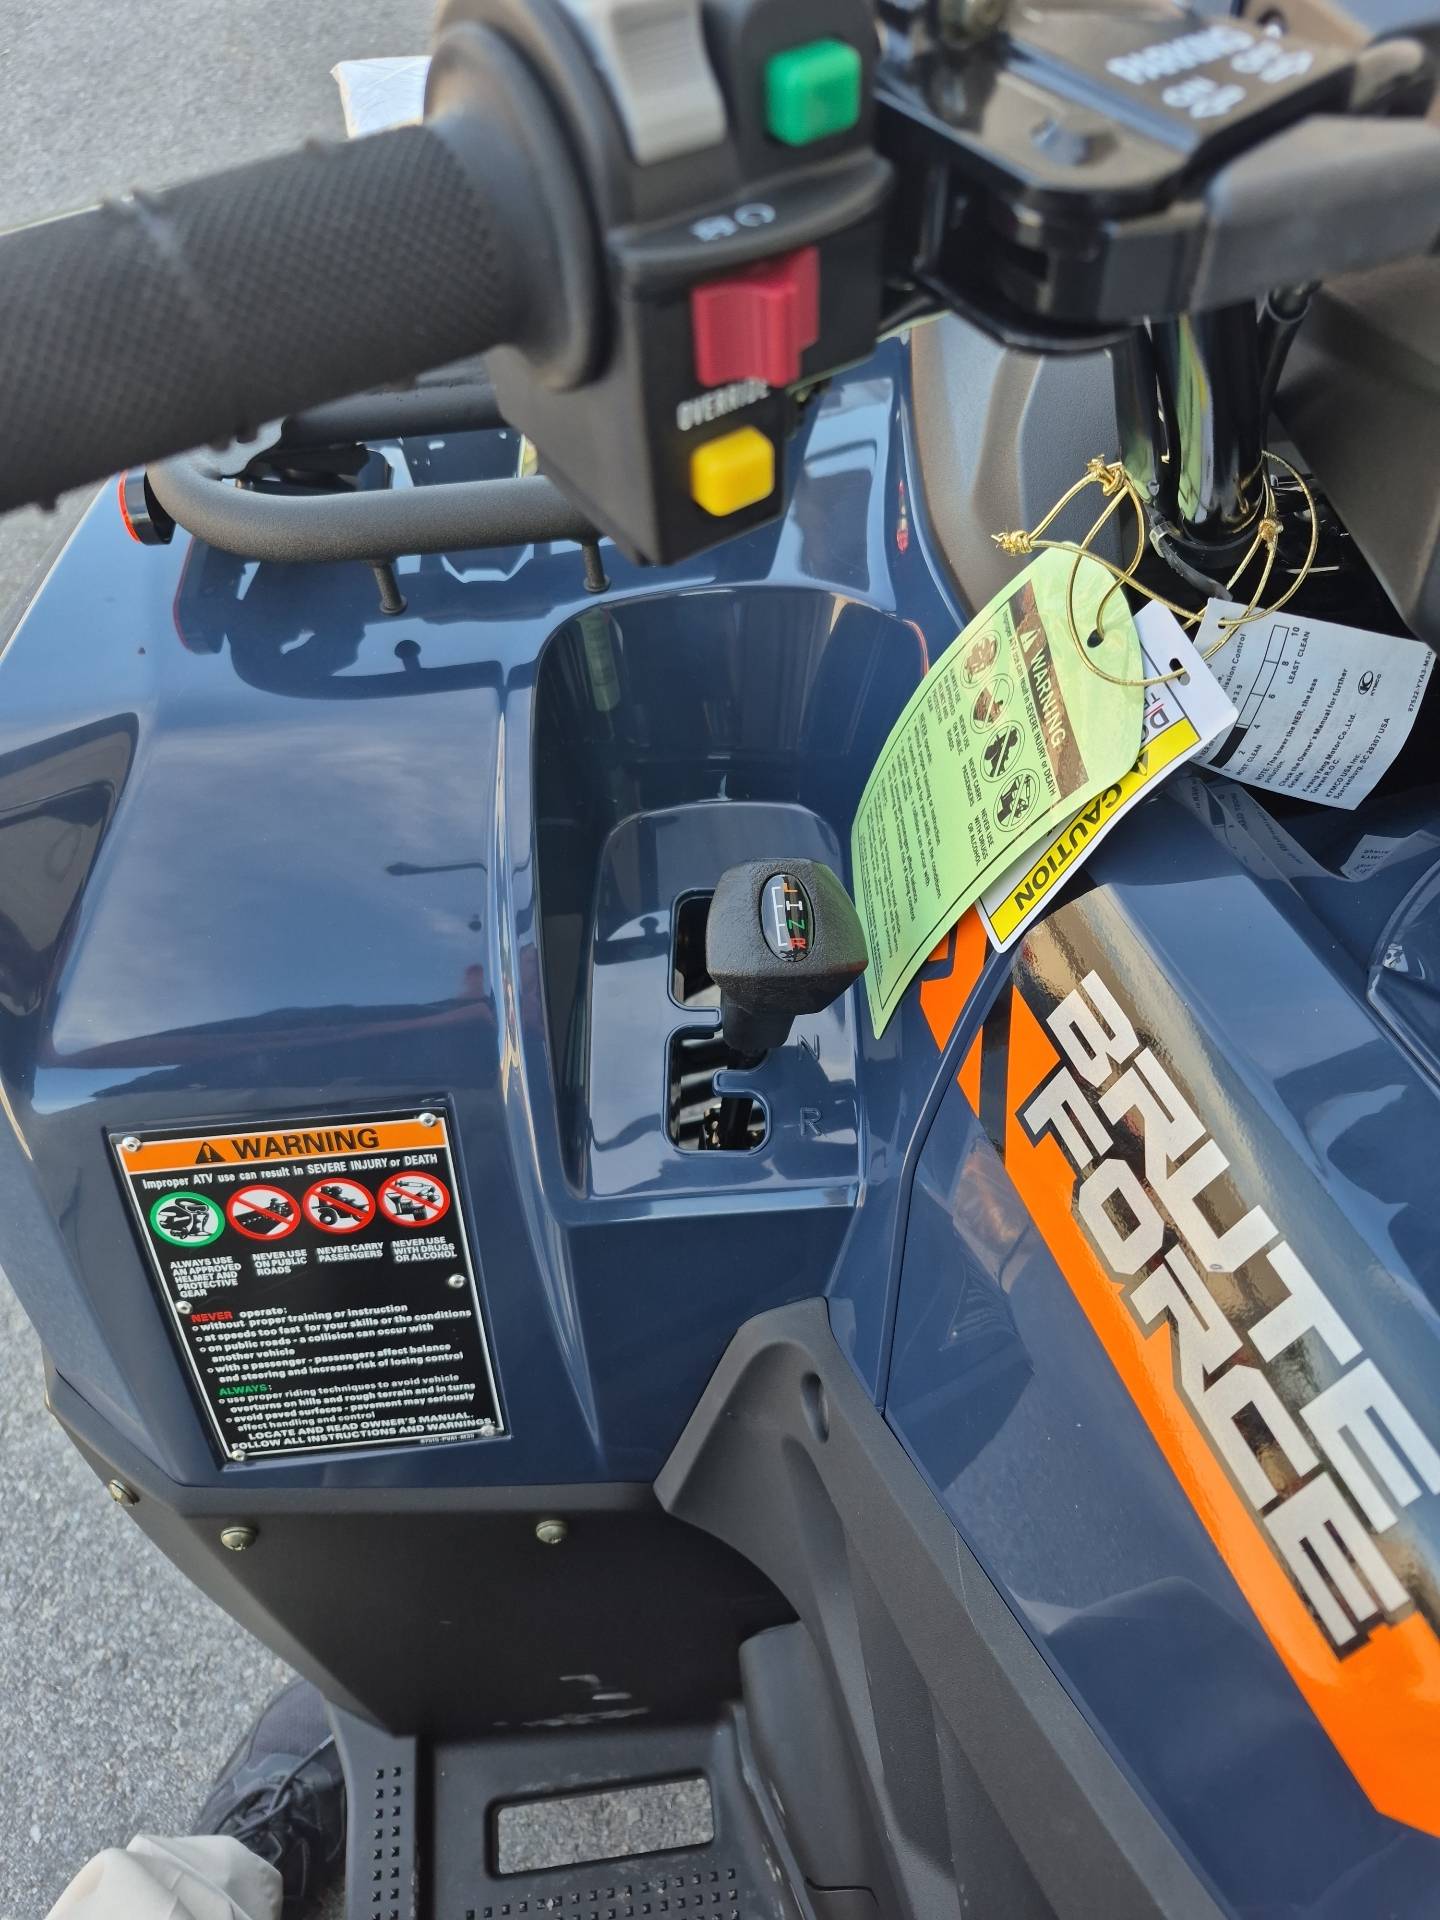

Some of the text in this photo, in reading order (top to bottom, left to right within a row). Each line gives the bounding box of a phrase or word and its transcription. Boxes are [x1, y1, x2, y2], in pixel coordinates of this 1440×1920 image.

[1291, 627, 1300, 636] 10
[1232, 633, 1246, 664] Control
[1287, 631, 1310, 684] LEAST CLEAN
[1370, 673, 1382, 696] KYMCO
[1031, 648, 1067, 748] WARNING
[1286, 726, 1295, 738] the
[1301, 694, 1310, 708] the
[1307, 678, 1318, 693] less
[1313, 710, 1331, 736] Manual
[1327, 697, 1336, 708] for
[1332, 668, 1348, 696] further
[1377, 718, 1390, 735] USA
[1025, 702, 1036, 733] SEVERE
[1034, 732, 1046, 760] INJURY
[1043, 767, 1056, 796] DEATH
[972, 777, 983, 802] CARRY
[973, 814, 989, 861] WITH DRUGS
[981, 807, 995, 848] NEVER USE
[970, 832, 981, 867] ALCOHOL
[1014, 784, 1122, 911] CAUTION
[784, 883, 798, 892] L
[786, 900, 803, 910] H
[788, 919, 805, 929] N
[790, 937, 806, 949] R
[800, 1106, 823, 1137] R
[231, 1127, 379, 1159] WARNING
[141, 1153, 438, 1190] Improper ATV use can result in SEVERE INJURY or DEATH
[316, 1241, 384, 1255] NEVER CARRY
[391, 1236, 446, 1248] NEVER USE
[393, 1242, 454, 1255] WITH DRUGS
[1046, 969, 1440, 1535] BRUTE
[169, 1255, 234, 1268] ALWAYS USE
[251, 1249, 307, 1261] NEVER USE
[254, 1256, 307, 1268] ON PUBLIC
[318, 1249, 383, 1262] PASSENGERS
[394, 1249, 457, 1262] OR ALCOHOL
[171, 1262, 241, 1276] AN APPROVED
[174, 1270, 238, 1283] HELMET AND
[256, 1265, 292, 1276] ROADS
[176, 1278, 238, 1291] PROTECTIVE
[179, 1288, 207, 1298] GEAR
[190, 1306, 288, 1323] NEVER operate:
[199, 1303, 408, 1331] without proper training or instruction
[216, 1329, 257, 1341] speeds
[257, 1328, 277, 1336] too
[278, 1324, 301, 1334] fast
[303, 1322, 321, 1332] for
[321, 1321, 349, 1332] your
[349, 1317, 379, 1328] skills
[379, 1317, 393, 1325] or
[393, 1314, 413, 1323] the
[413, 1308, 472, 1322] conditions
[207, 1344, 223, 1352] on
[223, 1340, 260, 1352] public
[258, 1336, 291, 1347] roads
[306, 1330, 355, 1343] collision
[355, 1330, 375, 1338] can
[376, 1326, 408, 1336] occur
[407, 1322, 434, 1333] with
[211, 1347, 296, 1363] another vehicle
[214, 1362, 241, 1373] with
[250, 1358, 307, 1371] passenger
[313, 1351, 376, 1364] passengers
[375, 1346, 408, 1357] affect
[408, 1342, 451, 1354] balance
[218, 1350, 464, 1383] and steering and increase risk of losing control
[1023, 1068, 1411, 1646] FORCE
[229, 1382, 476, 1413] overturns on hills and rough terrain and in turns
[247, 1392, 283, 1403] proper
[284, 1387, 317, 1398] riding
[317, 1381, 376, 1396] techniques
[376, 1380, 389, 1388] to
[390, 1377, 420, 1387] avoid
[421, 1373, 459, 1384] vehicle
[232, 1391, 475, 1423] avoid paved surfaces pavement may seriously
[230, 1417, 495, 1450] FOLLOW ALL INSTRUCTIONS AND WARNINGS.
[236, 1410, 375, 1432] affect handling and control
[247, 1428, 296, 1440] LOCATE
[296, 1426, 324, 1435] AND
[325, 1422, 359, 1432] READ
[359, 1416, 416, 1429] OWNER'S
